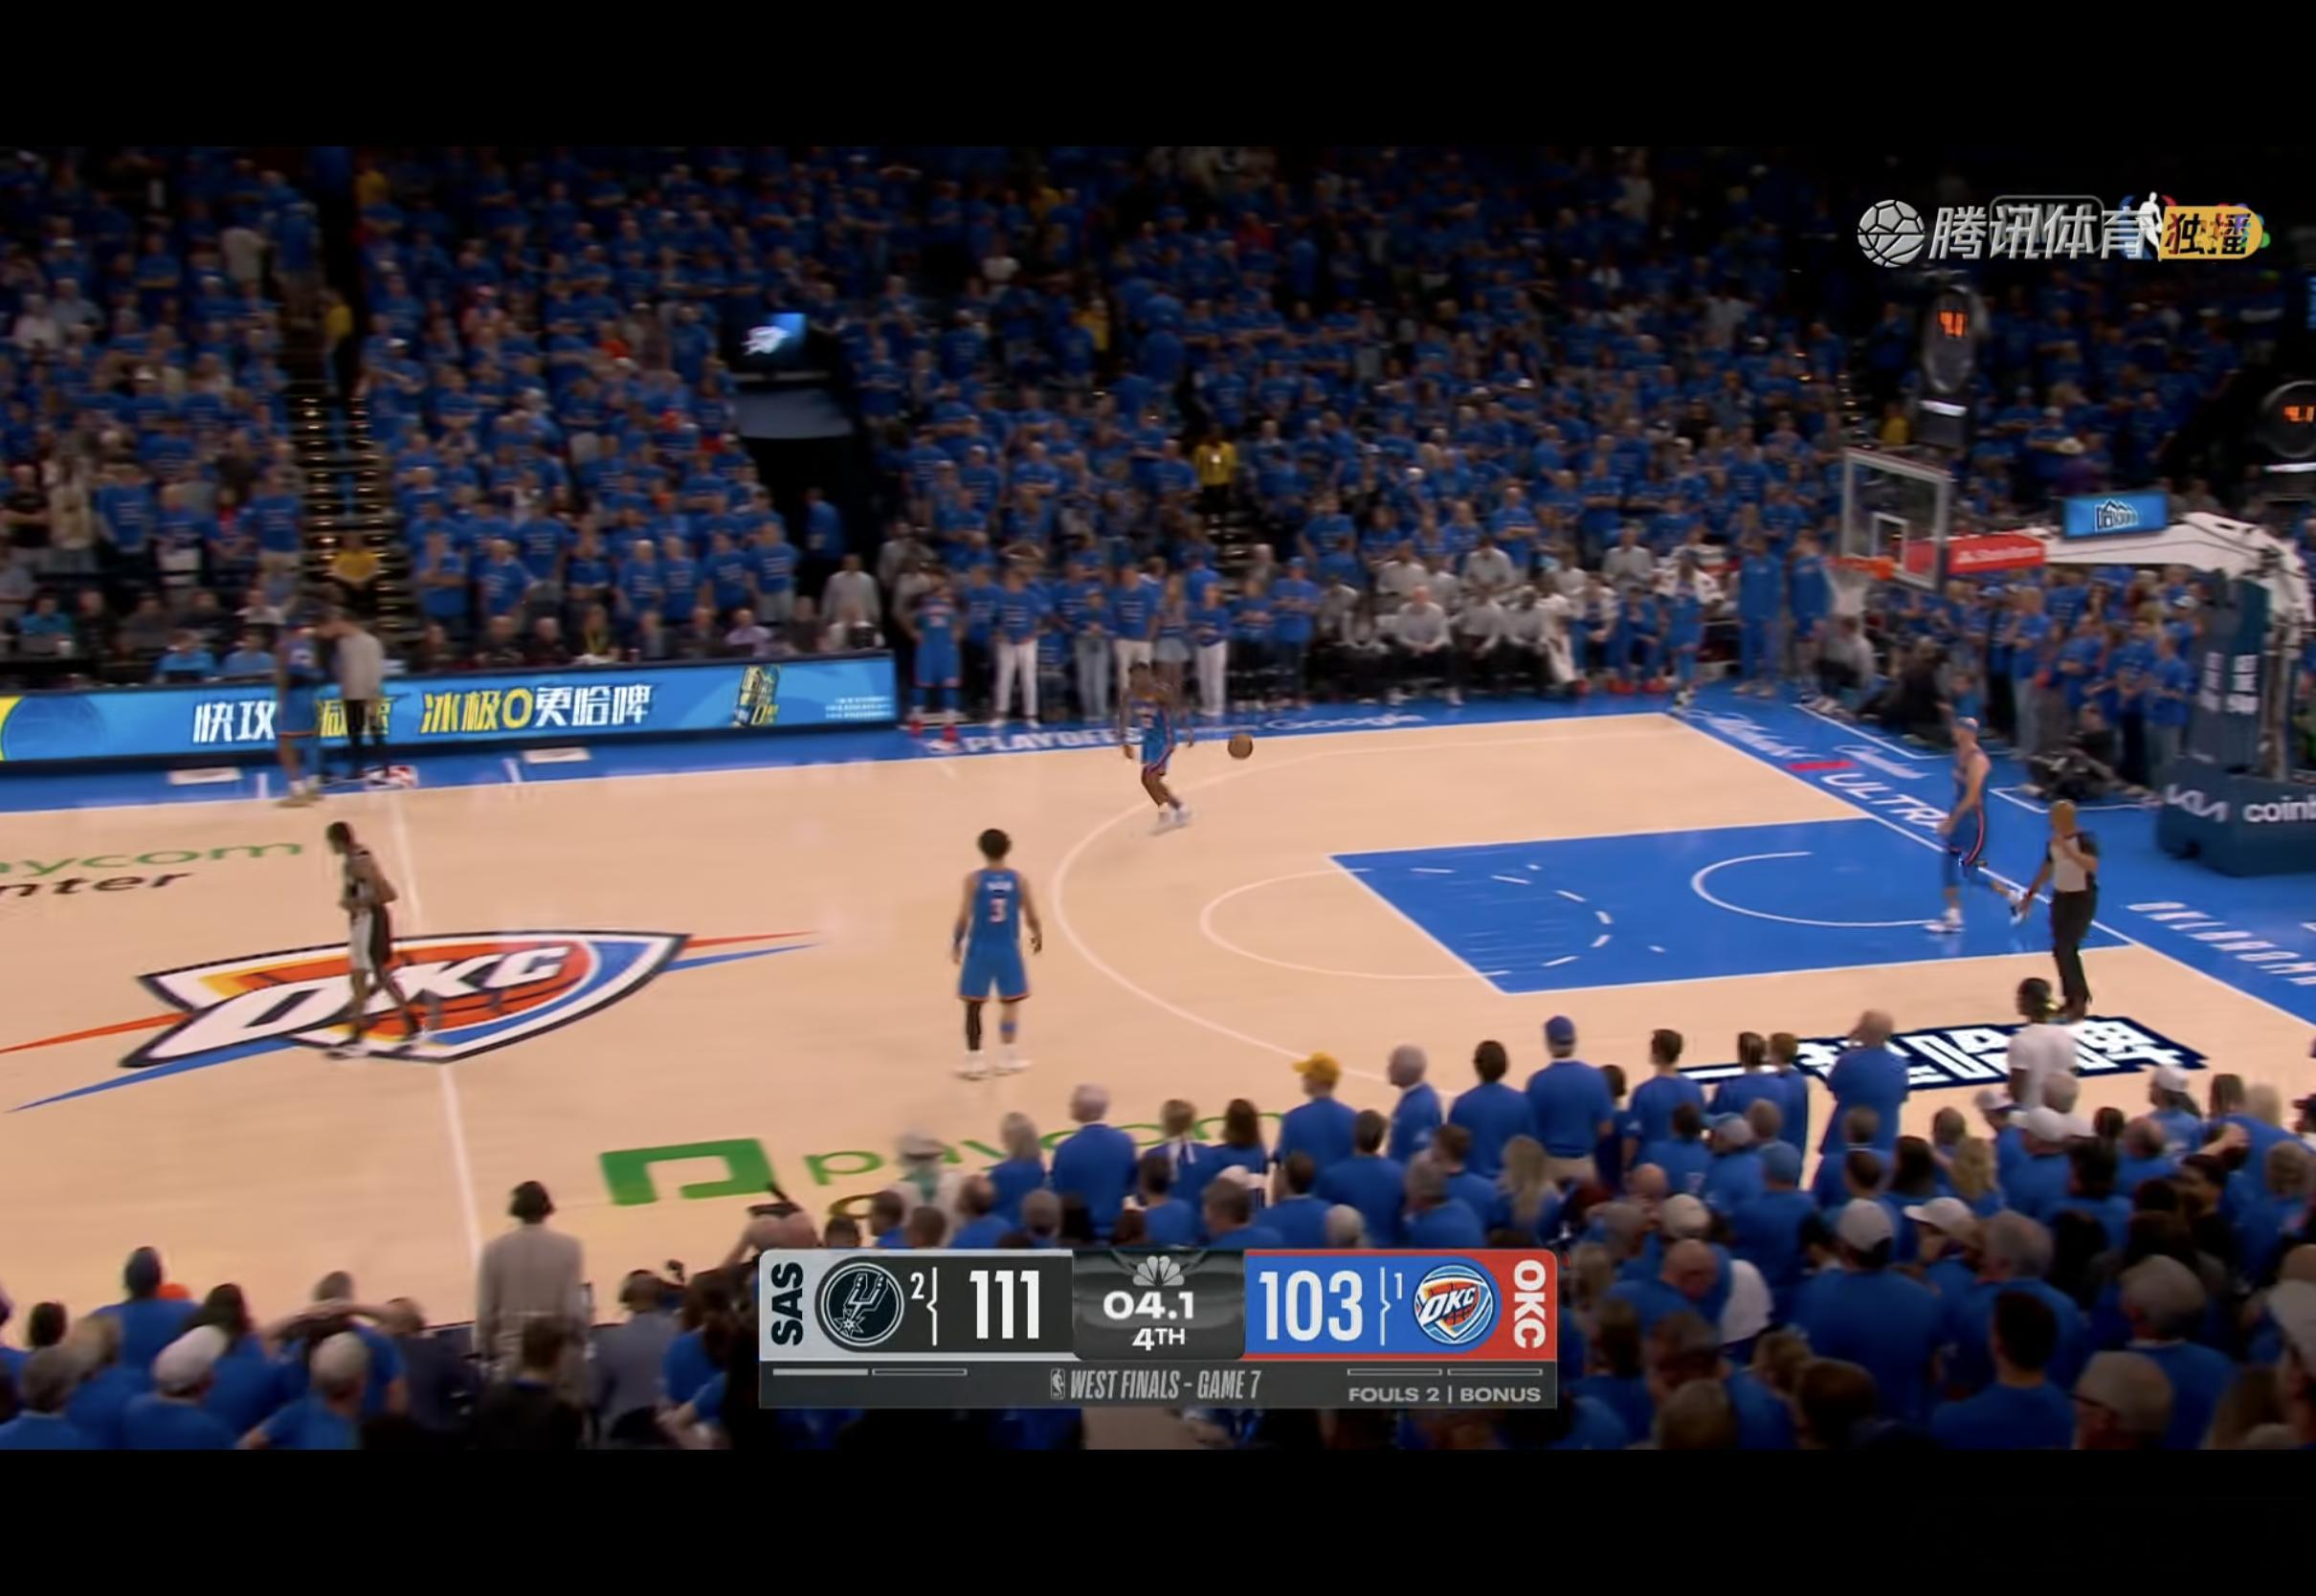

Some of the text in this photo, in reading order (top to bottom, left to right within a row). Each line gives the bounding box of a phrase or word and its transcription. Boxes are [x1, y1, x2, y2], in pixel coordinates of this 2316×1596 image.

[1263, 712, 1427, 730] Google
[2243, 794, 2316, 824] coin
[0, 842, 304, 877] ycom
[989, 897, 1008, 923] 3
